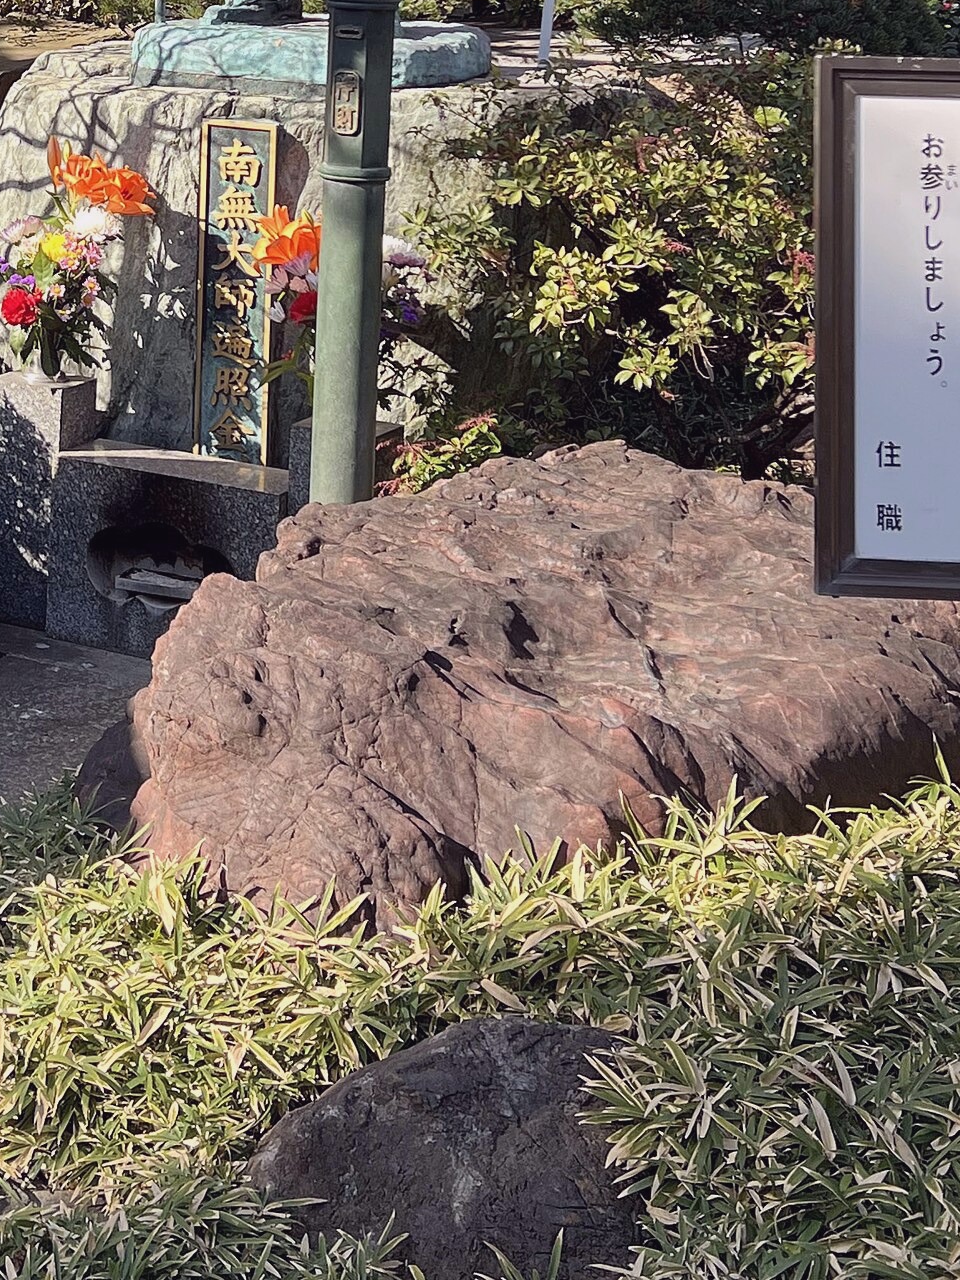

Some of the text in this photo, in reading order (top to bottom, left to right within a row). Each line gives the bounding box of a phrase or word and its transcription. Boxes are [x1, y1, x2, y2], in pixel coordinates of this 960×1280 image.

[920, 133, 948, 389] お参りしましょう。
[945, 164, 959, 191] まい
[211, 139, 263, 461] 南無大師遍照金
[876, 441, 902, 531] 住職
